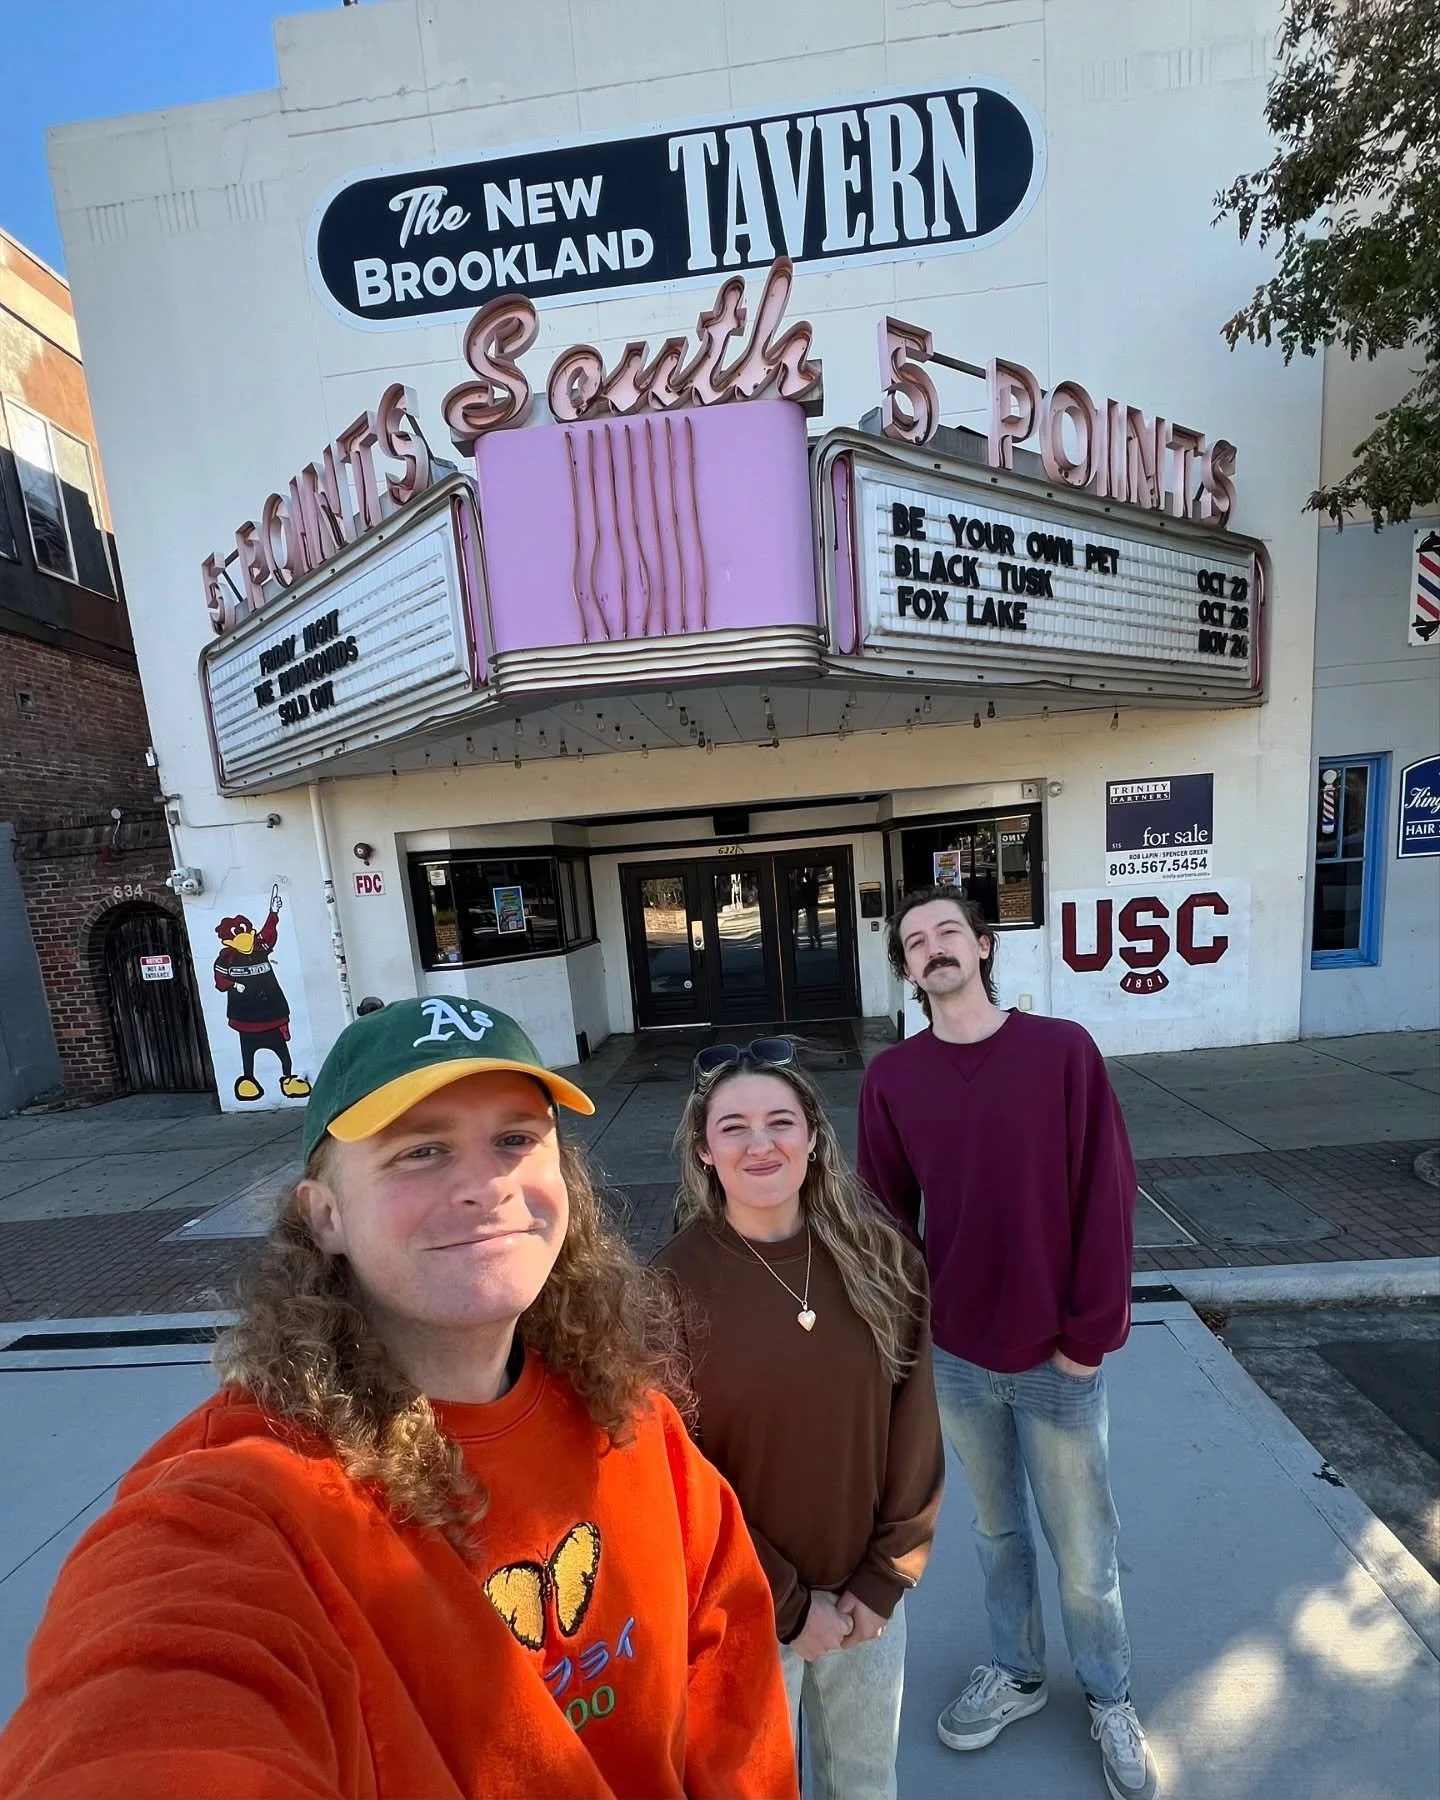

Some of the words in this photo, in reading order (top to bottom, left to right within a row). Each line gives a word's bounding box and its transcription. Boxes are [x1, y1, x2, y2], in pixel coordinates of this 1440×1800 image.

[669, 91, 978, 271] TAVERN
[389, 185, 471, 249] The
[483, 175, 603, 231] NEW
[354, 228, 654, 307] BROOKLAND
[441, 255, 822, 437] South
[877, 315, 939, 445] 5
[987, 357, 1238, 529] POINTS
[201, 552, 236, 635] 5
[235, 383, 430, 612] POINTS
[892, 502, 926, 541] BE
[948, 513, 1015, 556] YOUR
[1026, 531, 1074, 566] OWN
[1085, 543, 1120, 575] PET
[1197, 569, 1226, 596] OCT
[894, 544, 980, 588] BLACK
[998, 561, 1054, 598] TUSK
[1198, 600, 1226, 625] OCT
[259, 634, 296, 676] FRIDAY
[303, 608, 339, 652] NIGHT
[897, 585, 949, 621] FOX
[966, 595, 1028, 630] LAKE
[1198, 629, 1228, 655] NOV
[278, 694, 310, 726] SOLD
[310, 680, 335, 712] OUT
[1112, 783, 1168, 795] TRINITY
[1112, 793, 1168, 803] PARTNERS
[1142, 826, 1170, 847] for
[1174, 823, 1208, 844] sale
[1162, 849, 1188, 858] SPENCER
[1189, 848, 1208, 856] GREEN
[1406, 823, 1435, 836] HAIR
[113, 883, 143, 899] 634
[355, 874, 383, 894] FDC
[1109, 856, 1207, 877] 803.567.5454
[1061, 892, 1229, 972] USC
[1126, 975, 1163, 989] 1801
[412, 998, 494, 1048] A's
